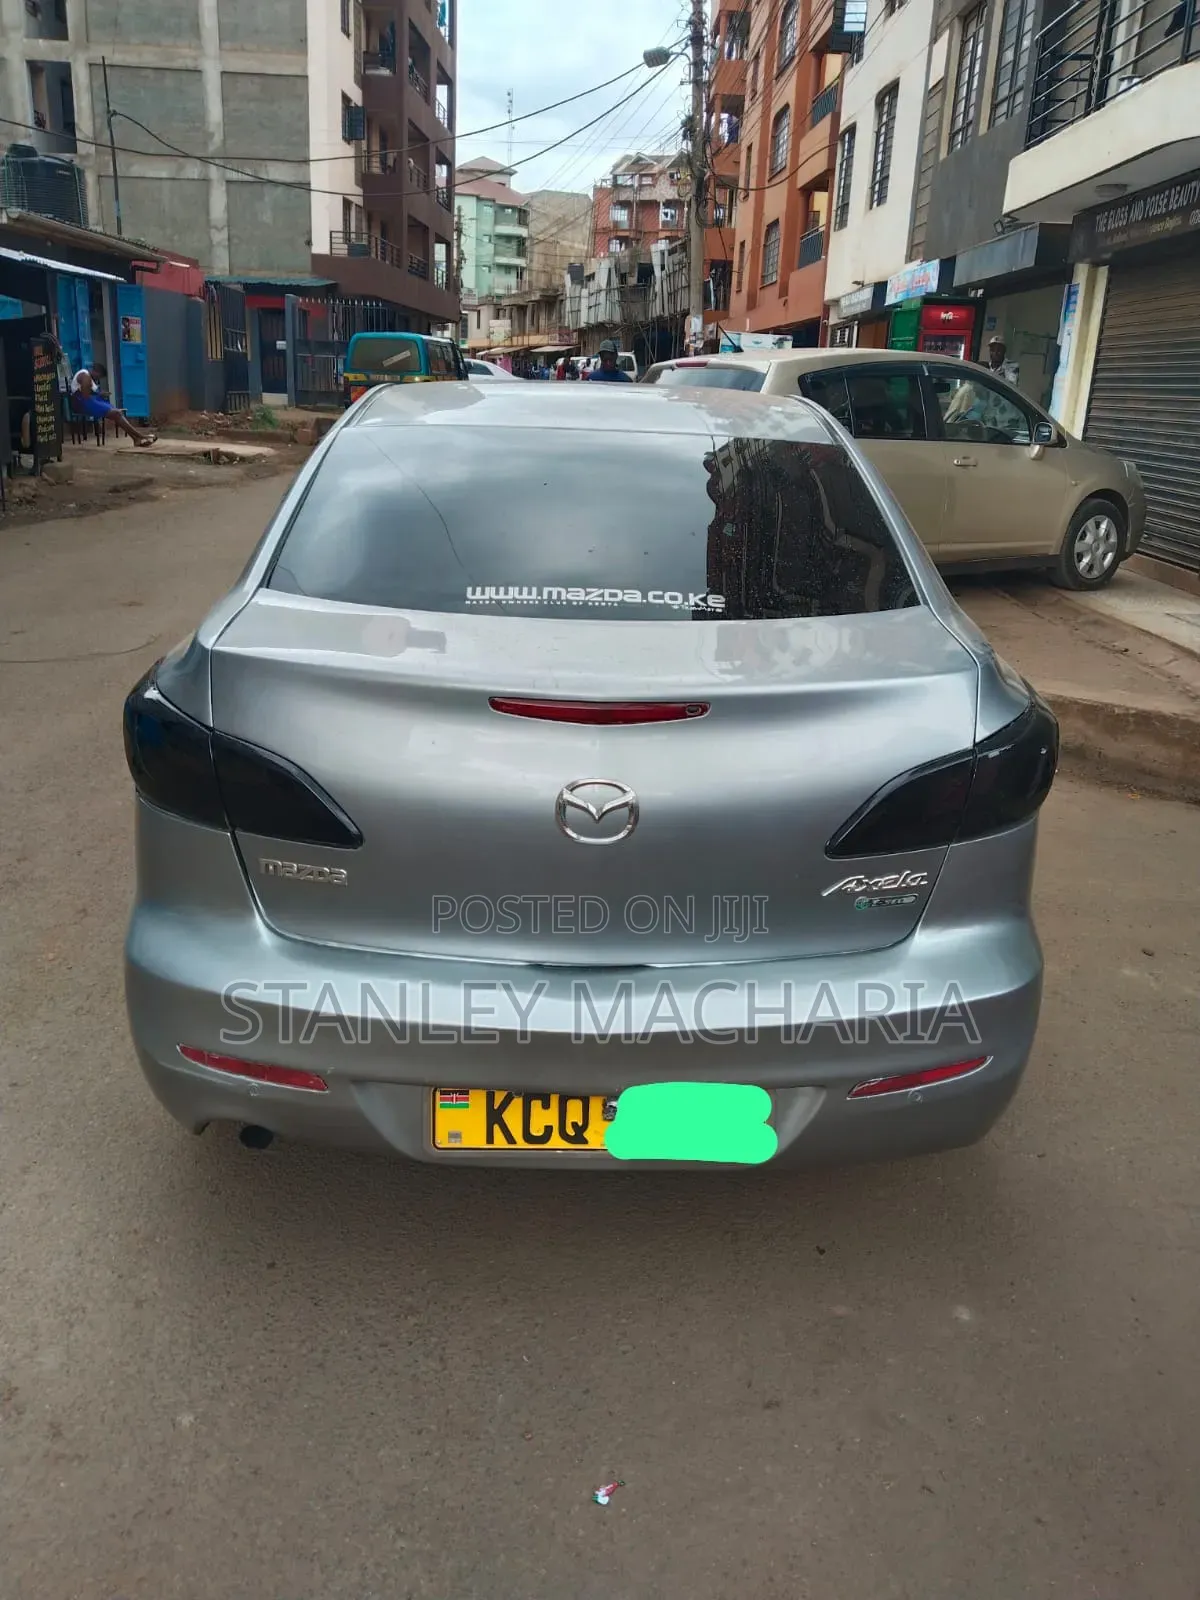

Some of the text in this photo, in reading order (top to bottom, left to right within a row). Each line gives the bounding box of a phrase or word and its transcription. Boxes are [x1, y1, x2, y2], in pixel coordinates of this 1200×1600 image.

[1095, 211, 1108, 233] THE
[1107, 205, 1129, 231] GLOSS
[1128, 199, 1144, 224] AND
[1144, 189, 1169, 218] POISE
[1168, 179, 1200, 211] BEAUTY
[485, 1089, 590, 1145] KCQ
